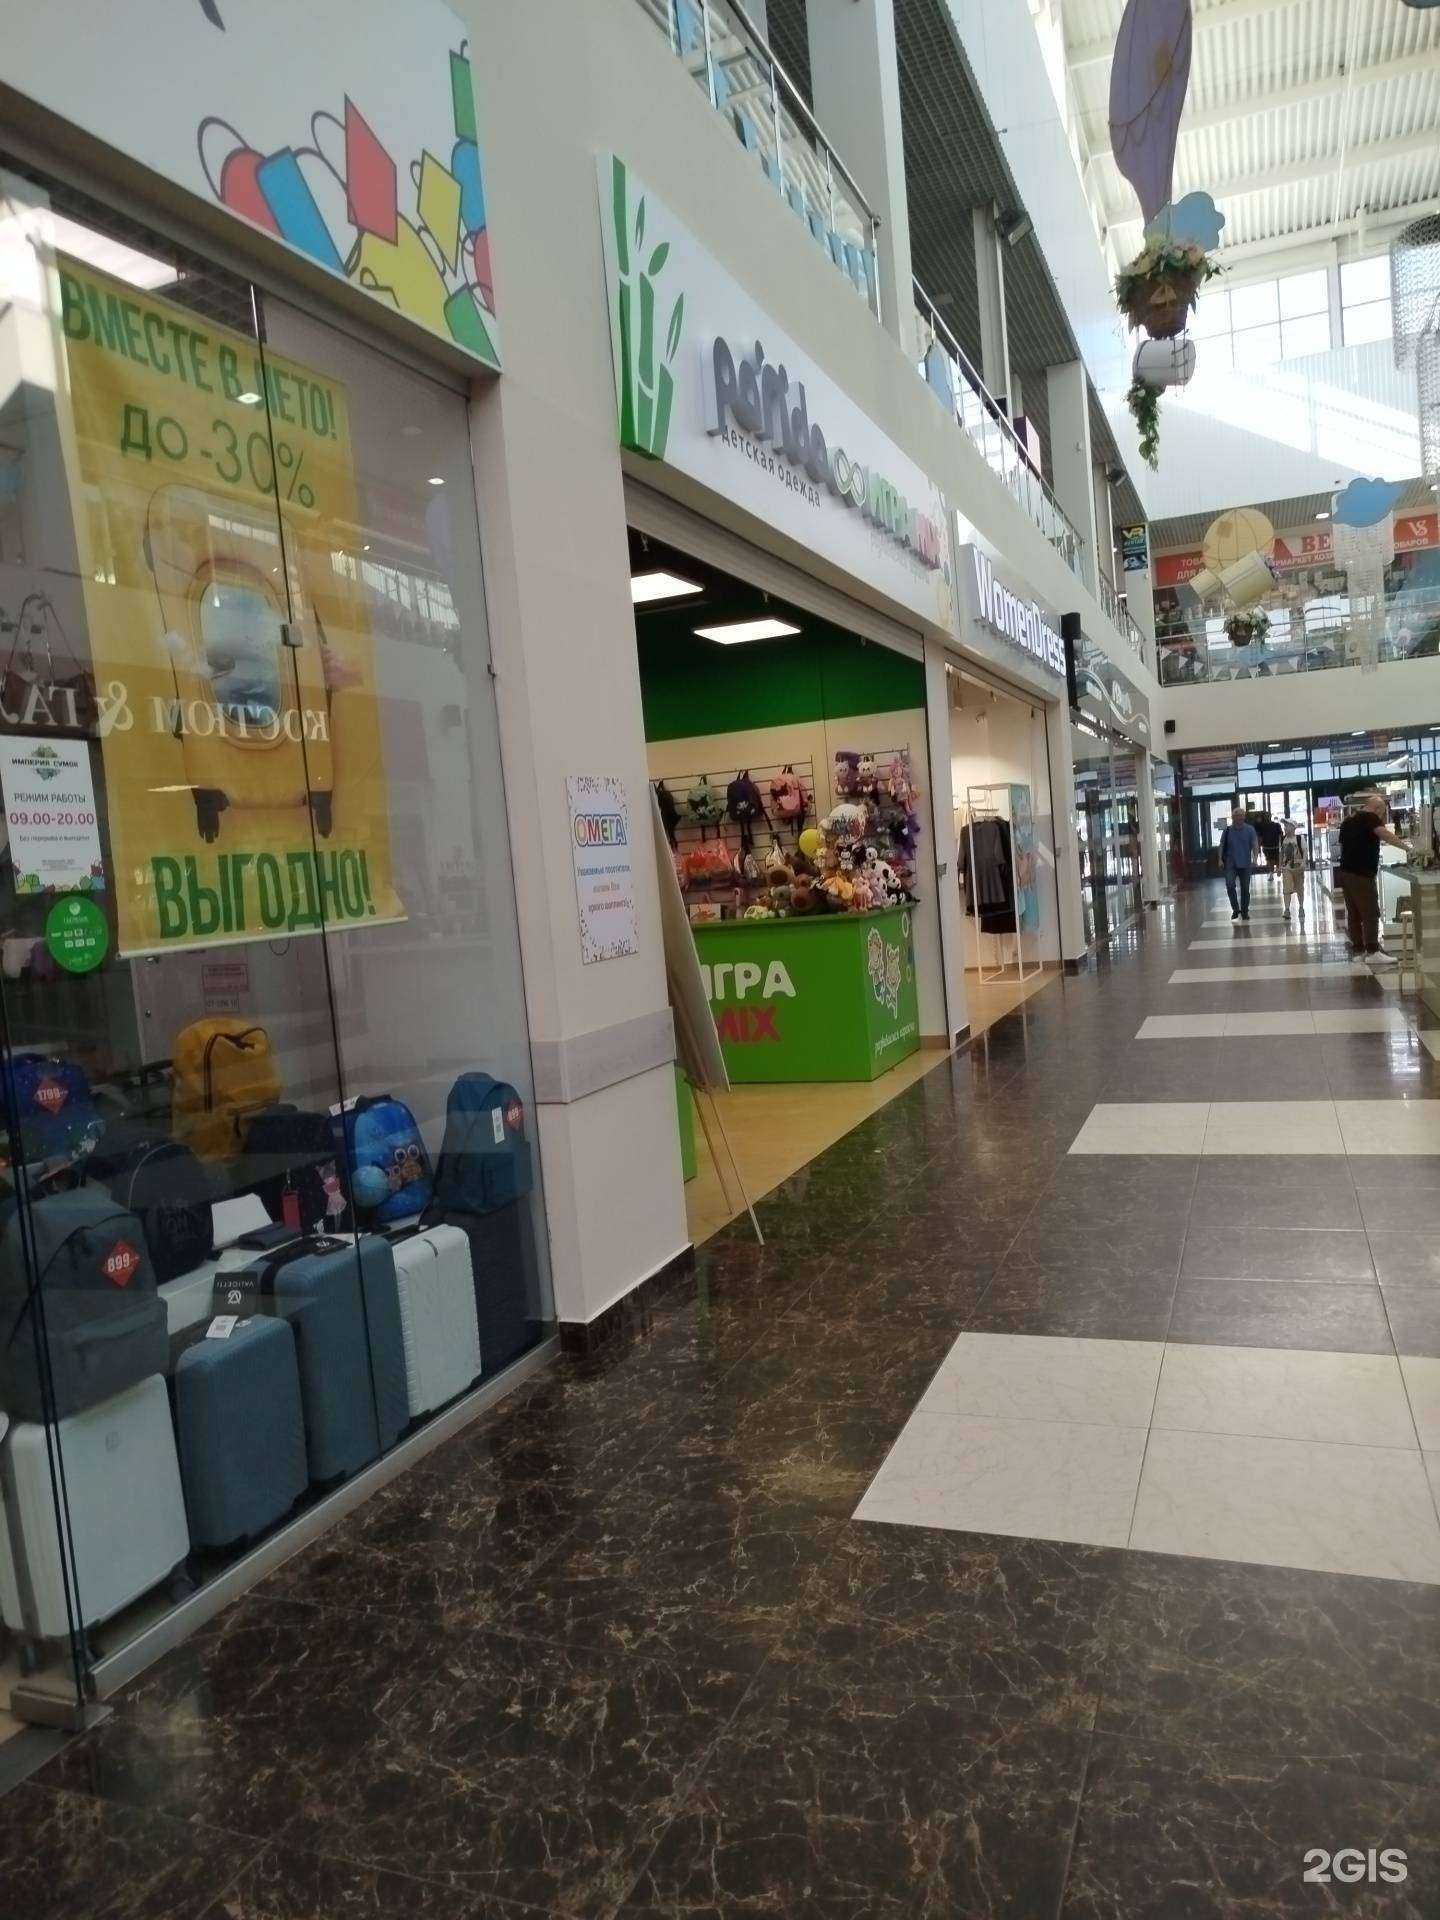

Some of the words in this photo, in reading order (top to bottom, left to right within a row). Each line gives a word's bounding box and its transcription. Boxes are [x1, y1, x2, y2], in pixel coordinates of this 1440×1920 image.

[62, 272, 213, 396] ВМЕСТЕ
[218, 346, 244, 402] В
[255, 360, 337, 440] ЛЕТО!
[121, 404, 188, 461] ДО
[201, 420, 315, 509] -30%
[721, 426, 775, 475] детская
[777, 465, 821, 509] одежда
[10, 812, 95, 826] 09.00-20.00
[14, 792, 49, 803] РЕЖИМ
[51, 793, 86, 804] РАБОТЫ
[575, 814, 627, 847] ОМЕГА
[151, 849, 376, 940] ВЫГОДНО!
[107, 1252, 130, 1273] 899
